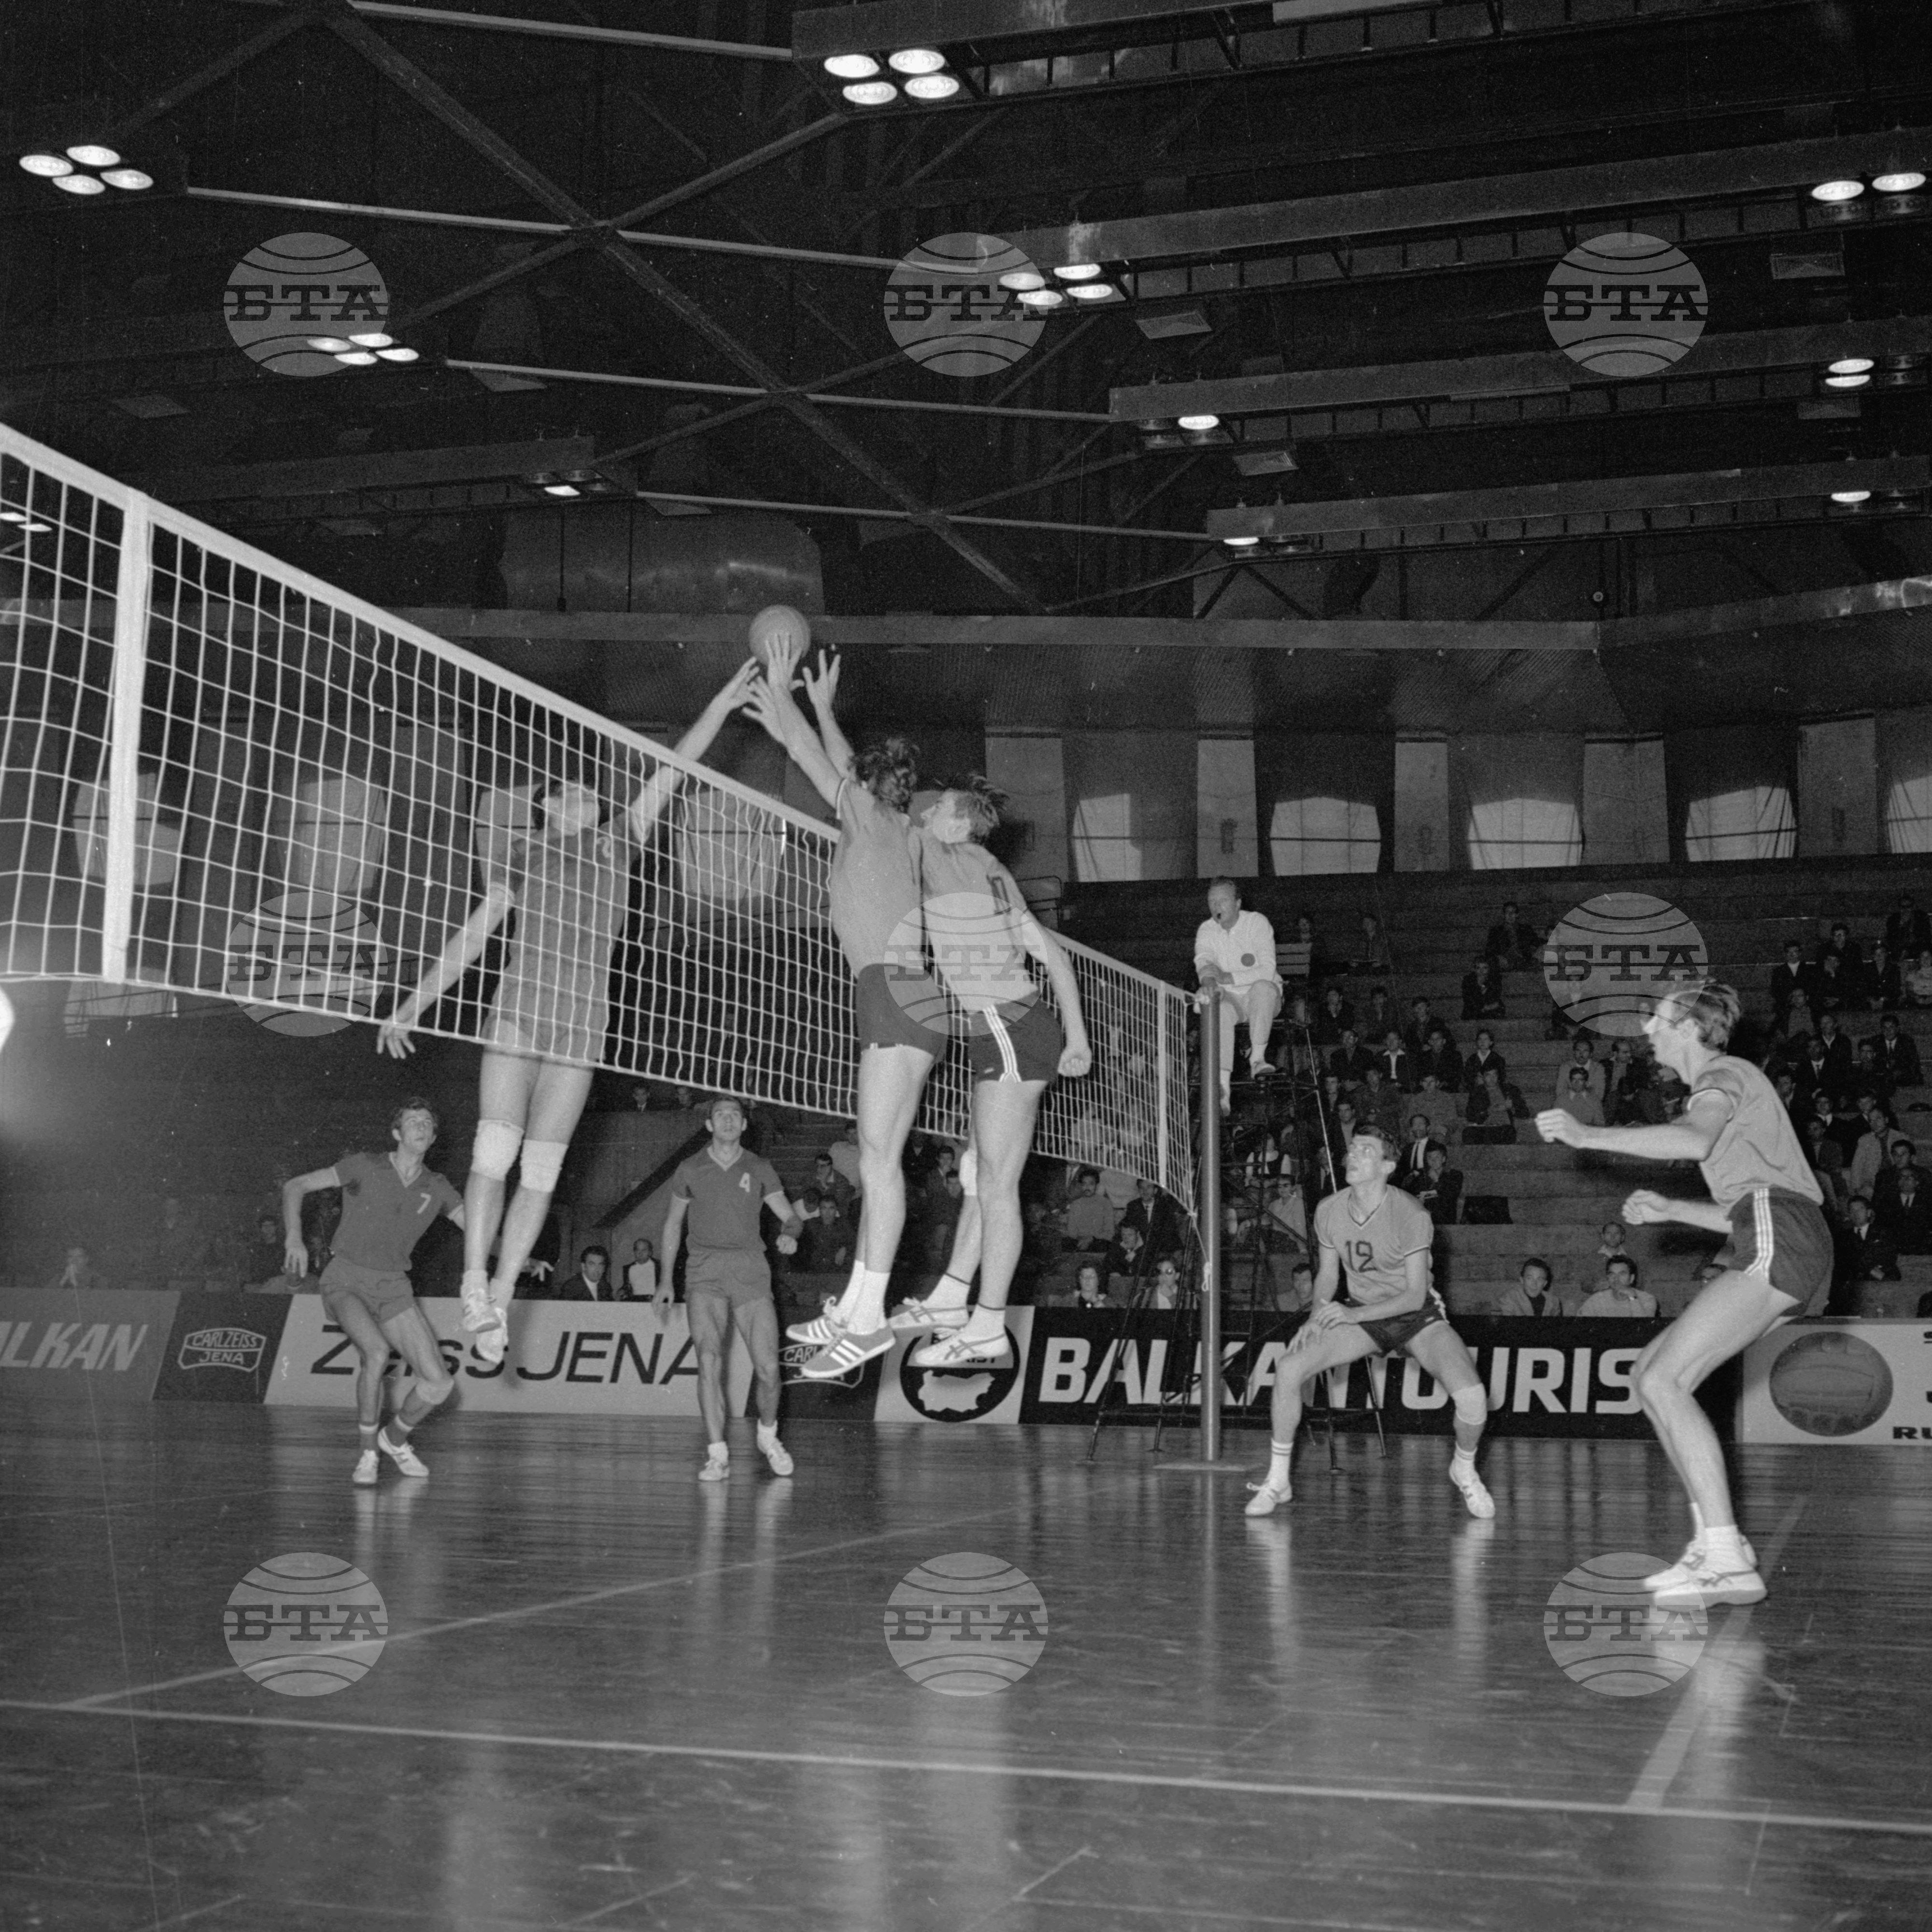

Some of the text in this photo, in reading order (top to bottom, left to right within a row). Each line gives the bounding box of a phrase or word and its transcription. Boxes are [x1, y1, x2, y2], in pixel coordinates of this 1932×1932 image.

[739, 1172, 751, 1193] 4
[417, 1192, 431, 1214] 7
[0, 1321, 148, 1371] LKAN
[199, 1351, 244, 1365] JENA
